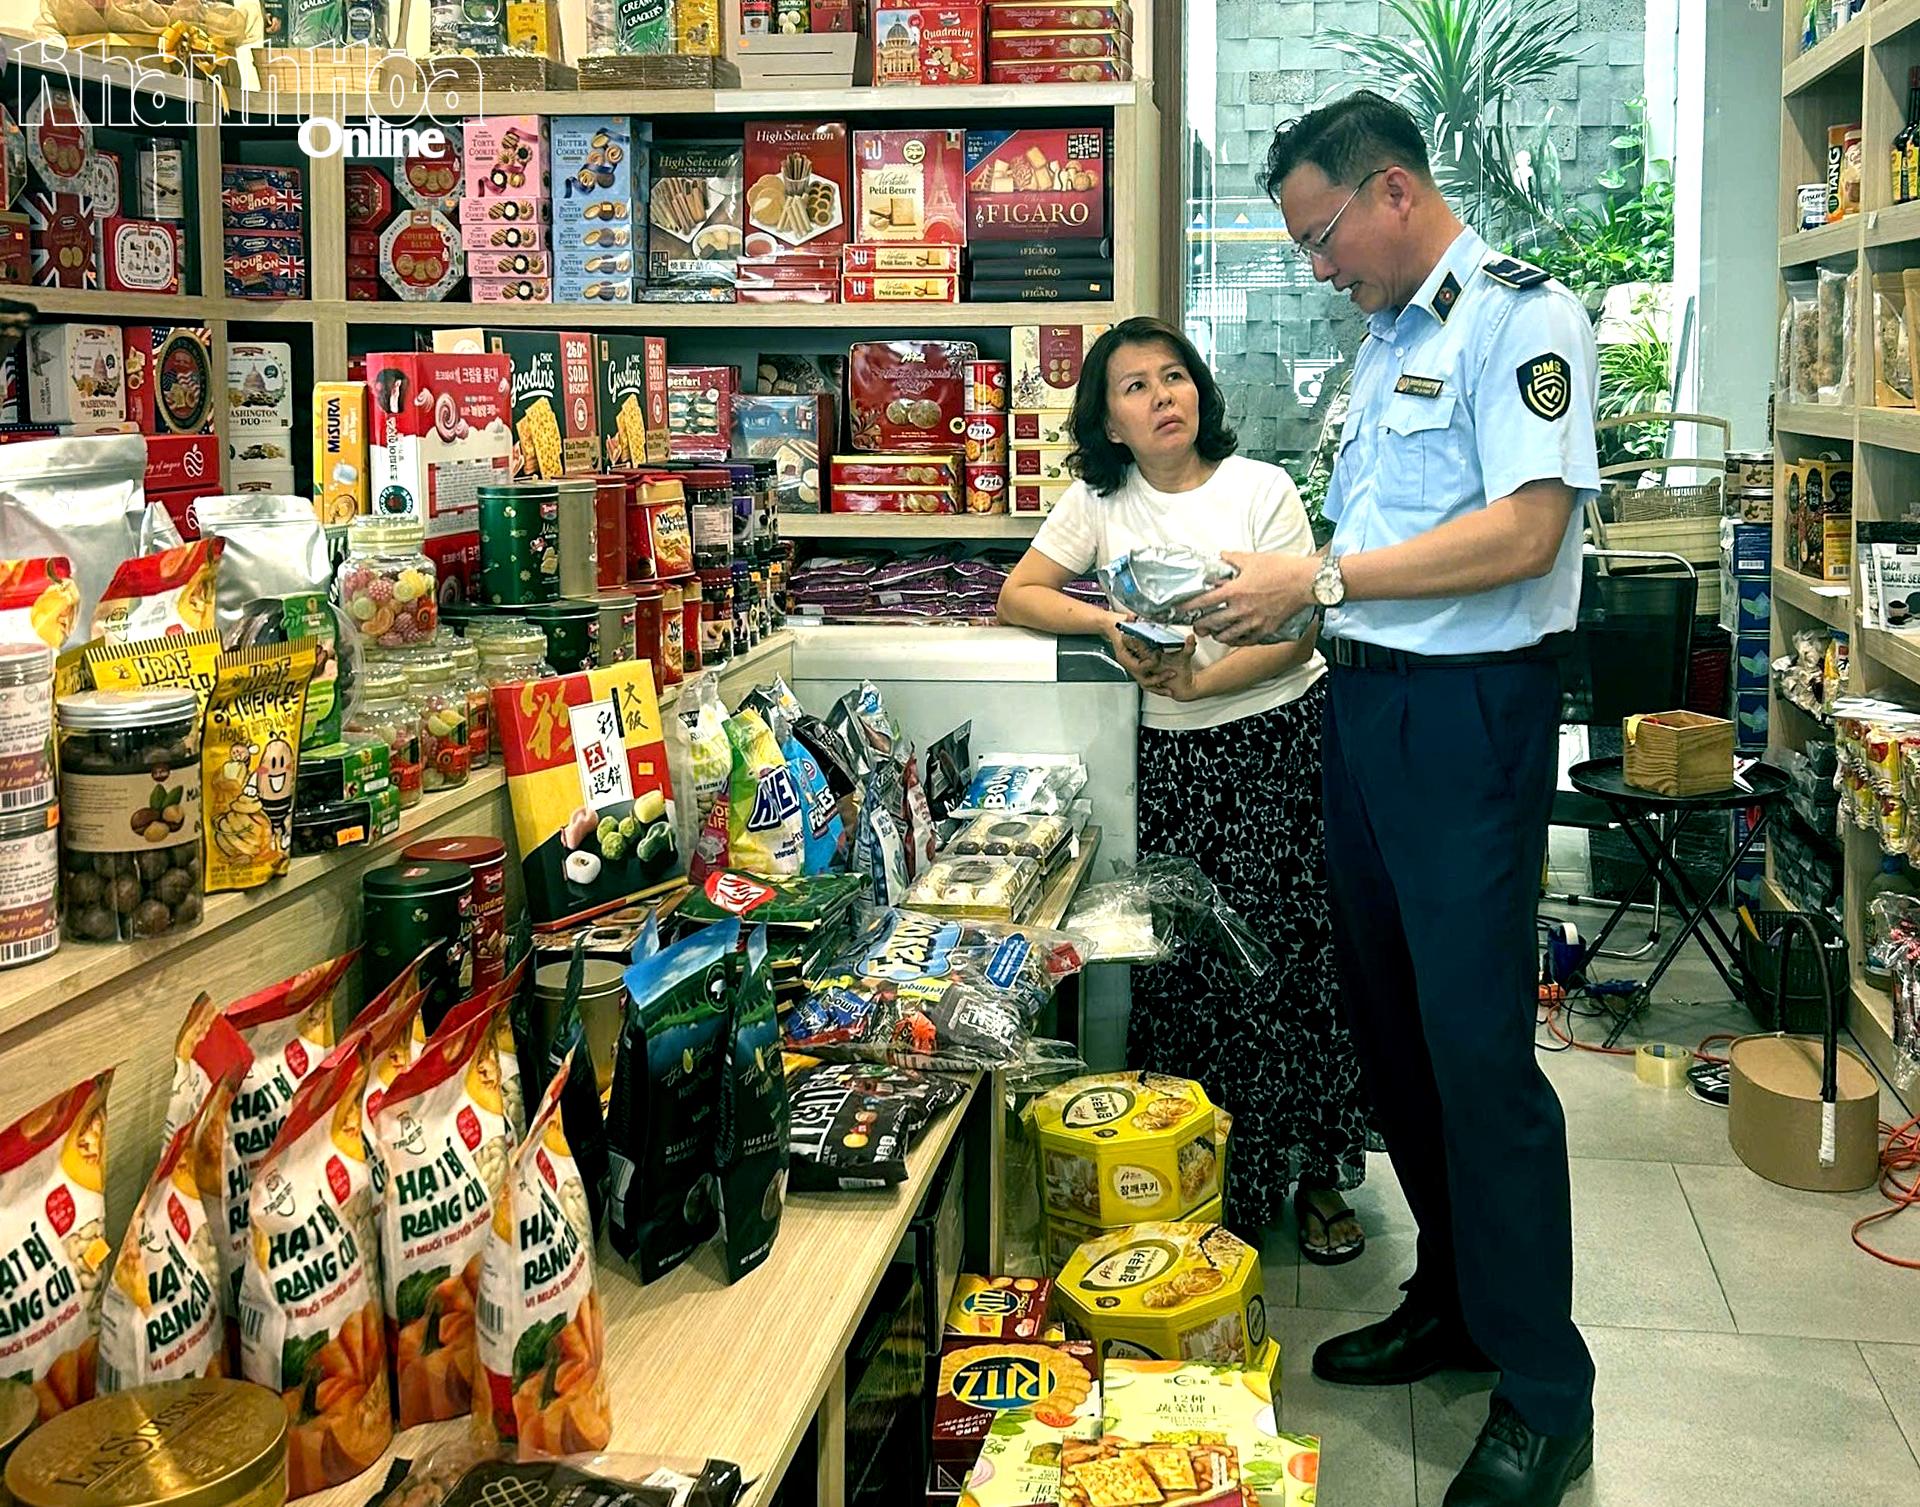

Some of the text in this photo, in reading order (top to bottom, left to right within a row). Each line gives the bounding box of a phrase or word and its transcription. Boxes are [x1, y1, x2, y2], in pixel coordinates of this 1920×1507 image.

[627, 5, 663, 26] CRACKERS
[923, 28, 974, 39] Quadratini
[471, 139, 495, 148] TORTE
[557, 139, 588, 147] BUTTER
[756, 129, 834, 143] High Selection
[468, 148, 499, 156] COOKIES
[556, 148, 589, 156] COOKIES
[659, 156, 736, 168] High Selection
[1828, 147, 1841, 193] TANG
[869, 186, 917, 195] Petit Beurre
[986, 202, 1089, 227] FIGARO
[854, 249, 868, 265] LU
[1023, 247, 1056, 256] FIGARO
[1027, 267, 1061, 276] FIGARO
[852, 280, 866, 295] LU
[1024, 290, 1058, 298] FIGARO
[567, 365, 589, 383] SODA
[649, 365, 663, 380] SODA
[1532, 360, 1562, 377] DMS
[92, 409, 107, 417] DUO
[240, 417, 261, 426] DUO
[327, 397, 341, 453] MiSURA
[132, 650, 191, 687] HBAF
[243, 657, 292, 692] HBAF
[274, 1064, 294, 1102] BÍ
[395, 1158, 450, 1205] HẠT
[443, 1137, 466, 1180] BÍ
[1120, 1180, 1158, 1197] 참깨쿠키
[401, 1172, 488, 1243] RANG CỦI
[269, 1214, 324, 1270] HẠT
[317, 1189, 341, 1237] BÍ
[0, 1221, 53, 1299] ẠT BÍ
[523, 1242, 570, 1291] RANG
[275, 1251, 338, 1305] RANG
[0, 1262, 76, 1338] ANG CỦI
[970, 1290, 1011, 1316] RITZ
[146, 1299, 200, 1354] RANG
[0, 1338, 24, 1358] UỐI
[956, 1362, 1049, 1401] RITZ
